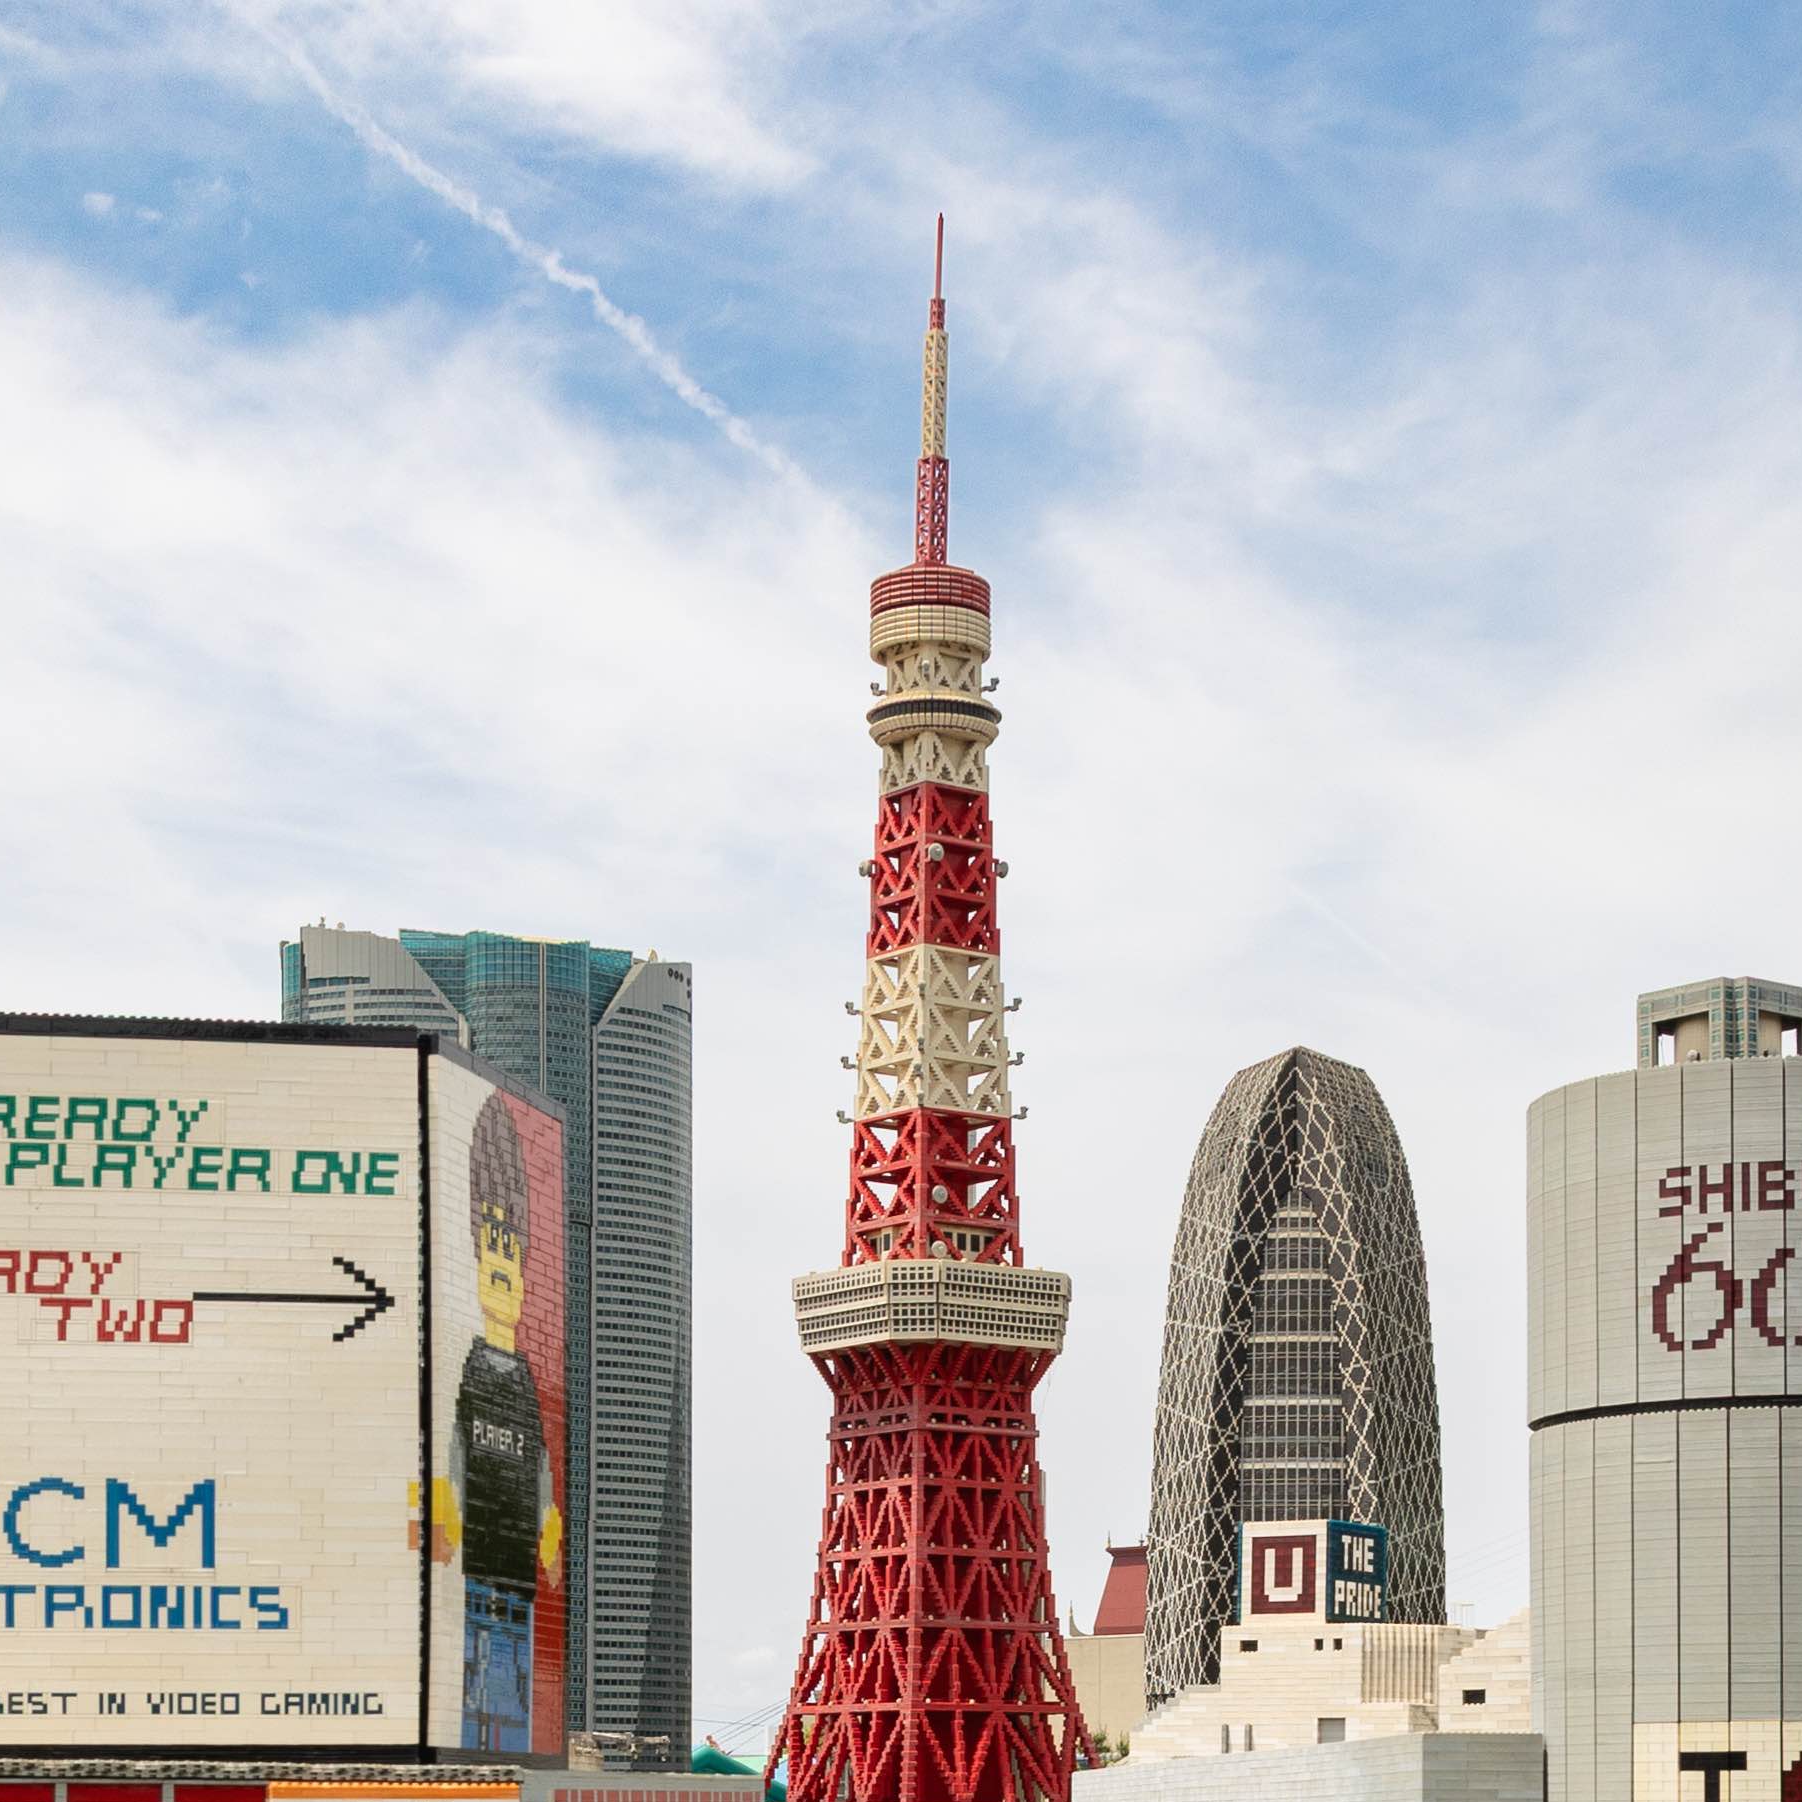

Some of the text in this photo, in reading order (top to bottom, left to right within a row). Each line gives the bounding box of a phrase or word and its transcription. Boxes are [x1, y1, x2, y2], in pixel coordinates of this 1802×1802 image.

[5, 1143, 397, 1195] PLAYER ONE
[55, 1297, 193, 1343] TWO
[473, 1420, 525, 1456] PLAYER 2
[1342, 1535, 1374, 1573] THE
[1264, 1548, 1303, 1602] U
[1335, 1580, 1382, 1620] PRIDE
[99, 1693, 126, 1715] IN
[147, 1692, 240, 1715] VIDEO
[261, 1693, 384, 1715] GAMING
